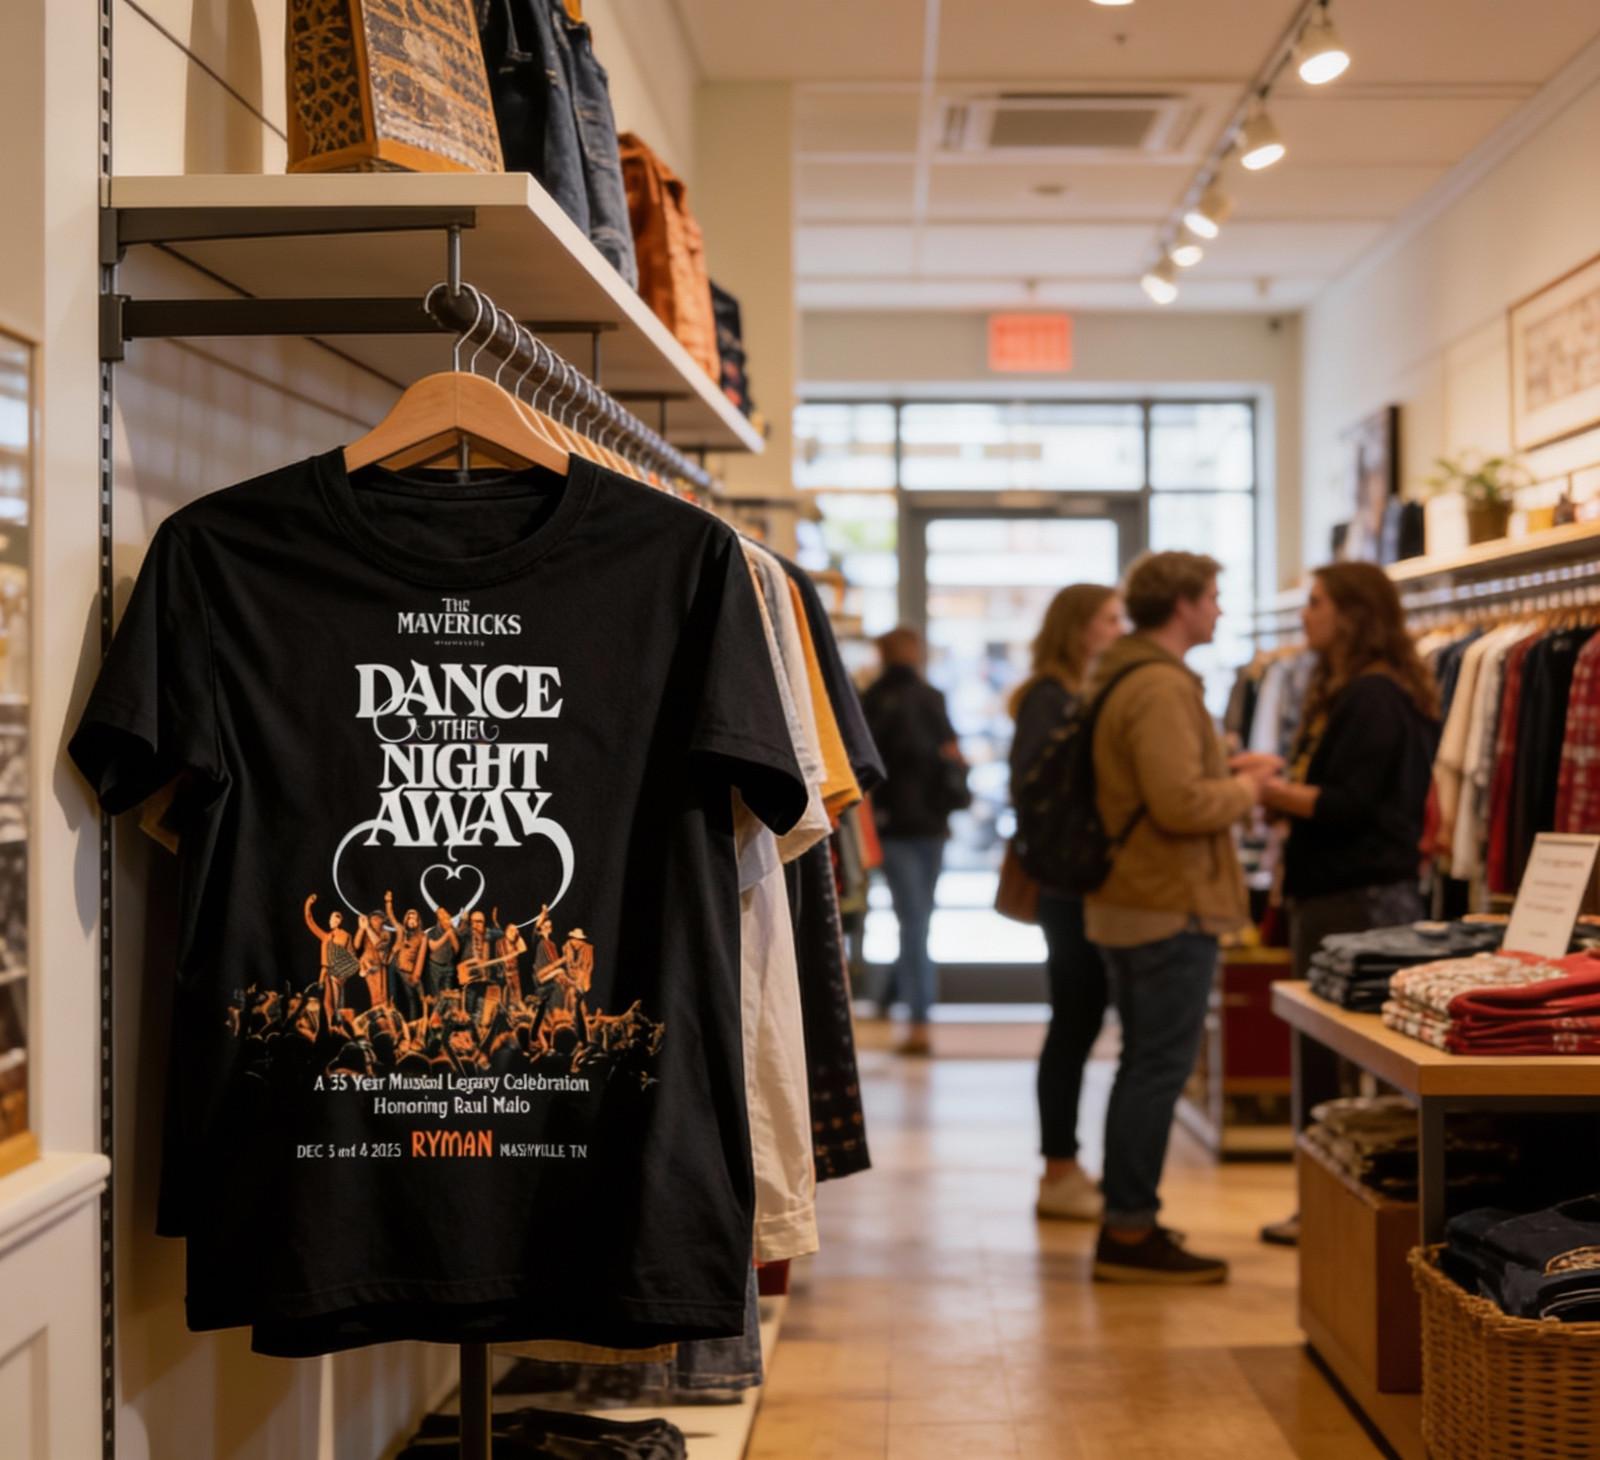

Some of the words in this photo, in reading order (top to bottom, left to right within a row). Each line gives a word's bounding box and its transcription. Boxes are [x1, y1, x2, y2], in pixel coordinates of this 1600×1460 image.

[397, 612, 522, 636] MAVERICKS
[355, 659, 563, 719] DANCE
[377, 743, 548, 789] NIGHT
[362, 784, 553, 847] AWAY
[313, 1075, 325, 1091] A
[330, 1074, 348, 1091] 35
[374, 1094, 448, 1119] Honoring
[493, 1095, 531, 1114] Malo
[296, 1144, 324, 1159] DEC
[412, 1130, 493, 1158] RYMAN
[568, 1144, 588, 1159] TN
